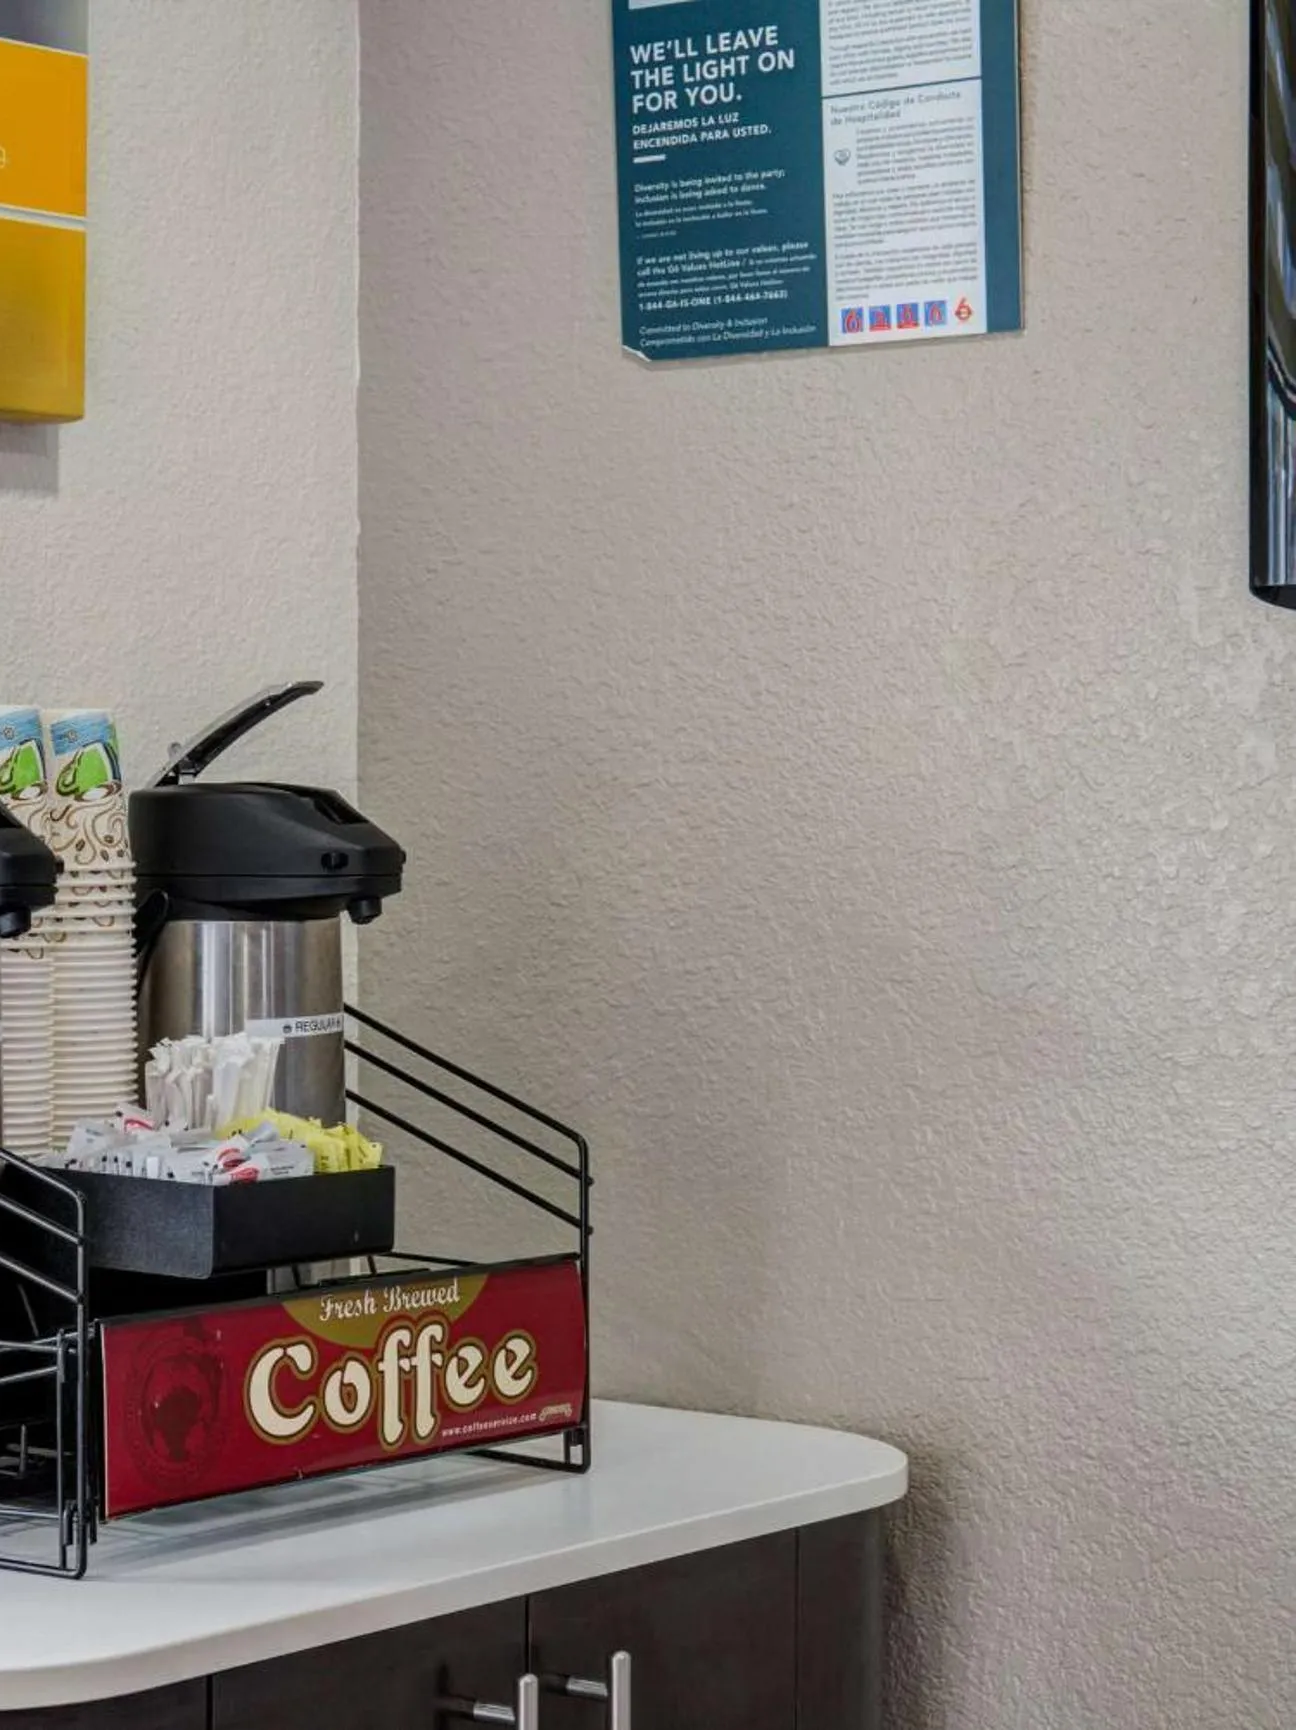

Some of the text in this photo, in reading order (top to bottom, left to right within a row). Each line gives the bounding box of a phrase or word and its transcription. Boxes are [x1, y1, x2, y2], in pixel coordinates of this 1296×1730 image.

[630, 25, 778, 64] WE'LL LEAVE
[630, 48, 795, 89] THE LIGHT ON
[632, 82, 742, 114] FOR YOU.
[632, 112, 740, 135] DEJAREMOS LA LUZ
[633, 123, 772, 150] ENCENDIDA PARA USTED.
[320, 1277, 460, 1321] Fresh Brewed
[247, 1320, 534, 1447] Coffee
